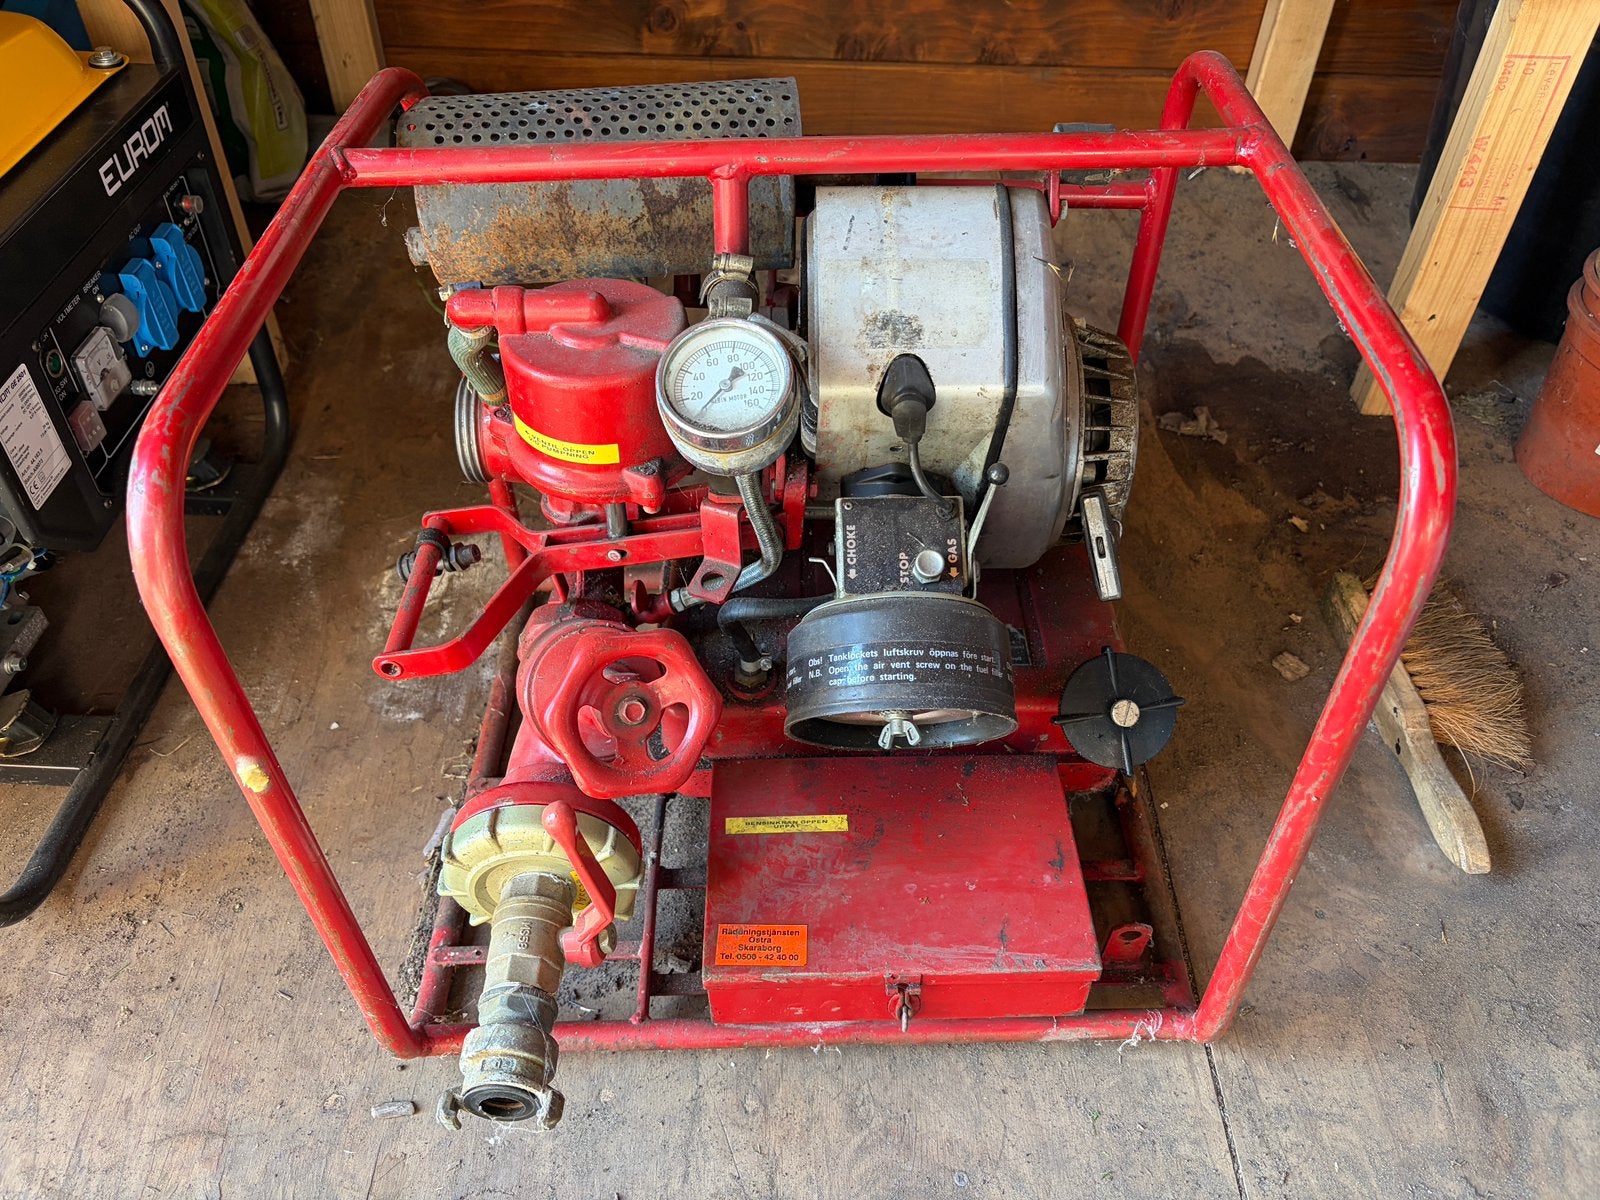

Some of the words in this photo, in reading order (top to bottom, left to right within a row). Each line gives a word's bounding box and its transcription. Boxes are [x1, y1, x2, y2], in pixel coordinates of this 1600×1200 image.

[99, 104, 173, 197] EUROM
[82, 270, 102, 293] BREAKER
[56, 294, 81, 324] VOLTMETER
[706, 358, 718, 366] 60
[727, 354, 739, 362] 80
[740, 362, 755, 371] 100
[693, 372, 705, 380] 40
[748, 372, 763, 381] 120
[749, 386, 764, 395] 140
[691, 392, 703, 400] 20
[744, 399, 759, 408] 160
[847, 525, 856, 565] CHOKE
[947, 539, 957, 563] GAS
[899, 552, 909, 583] STOP
[809, 656, 823, 667] Obs!
[828, 649, 878, 662] Tanklockets
[883, 648, 924, 657] luftskruv
[929, 648, 959, 658] öppnas
[962, 650, 978, 660] före
[808, 670, 822, 680] N.B.
[828, 665, 849, 676] Open
[855, 662, 868, 671] the
[874, 661, 885, 669] air
[890, 660, 910, 669] vent
[915, 661, 940, 669] screw
[960, 663, 973, 672] the
[976, 665, 989, 674] fuel
[880, 672, 917, 682] starting.
[738, 944, 781, 952] Skaraborg
